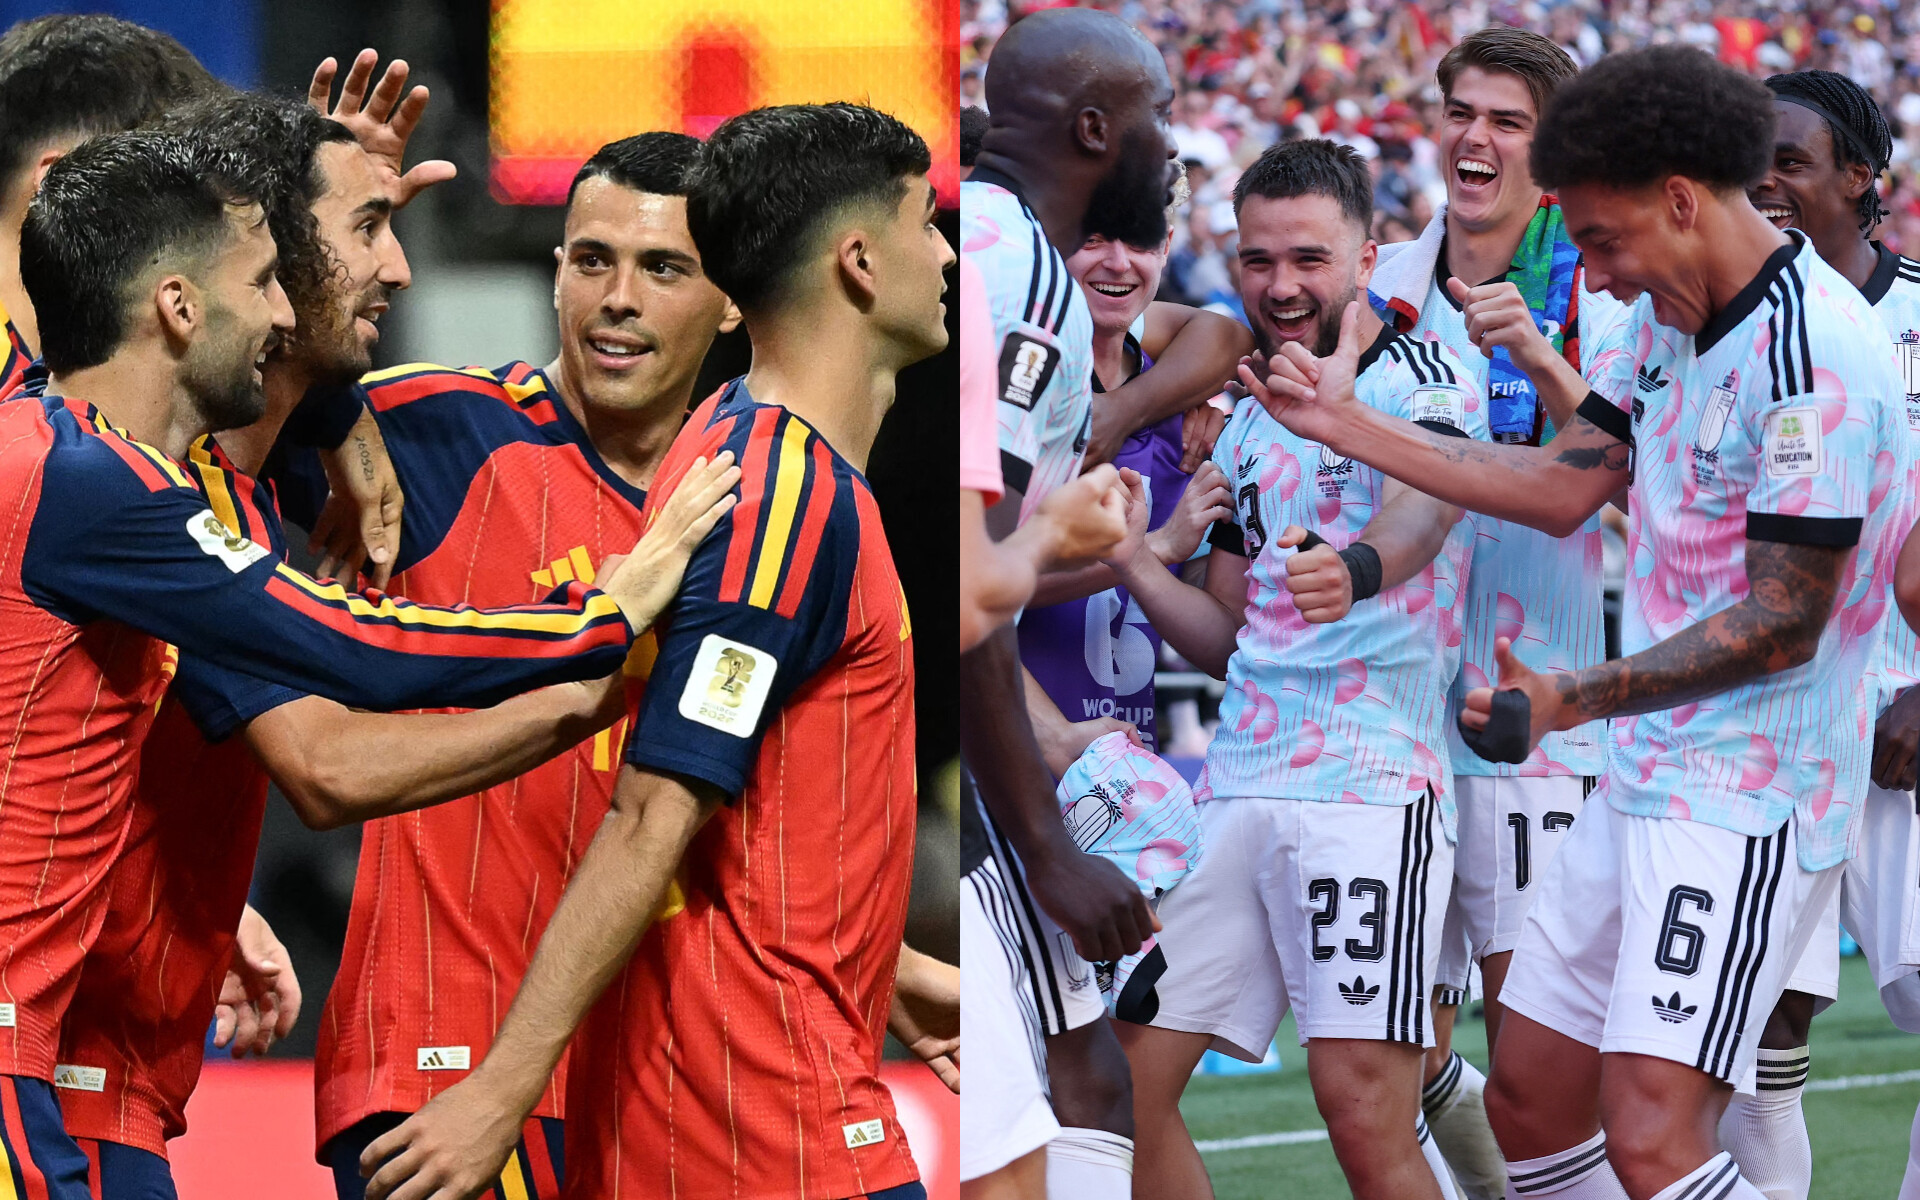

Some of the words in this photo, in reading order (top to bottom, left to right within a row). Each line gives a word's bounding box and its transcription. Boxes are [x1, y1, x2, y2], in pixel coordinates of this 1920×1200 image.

[1492, 379, 1530, 396] FIFA
[1774, 451, 1812, 464] EDUCATION
[1116, 706, 1154, 726] CUP
[1309, 877, 1390, 963] 23
[1654, 884, 1716, 979] 6
